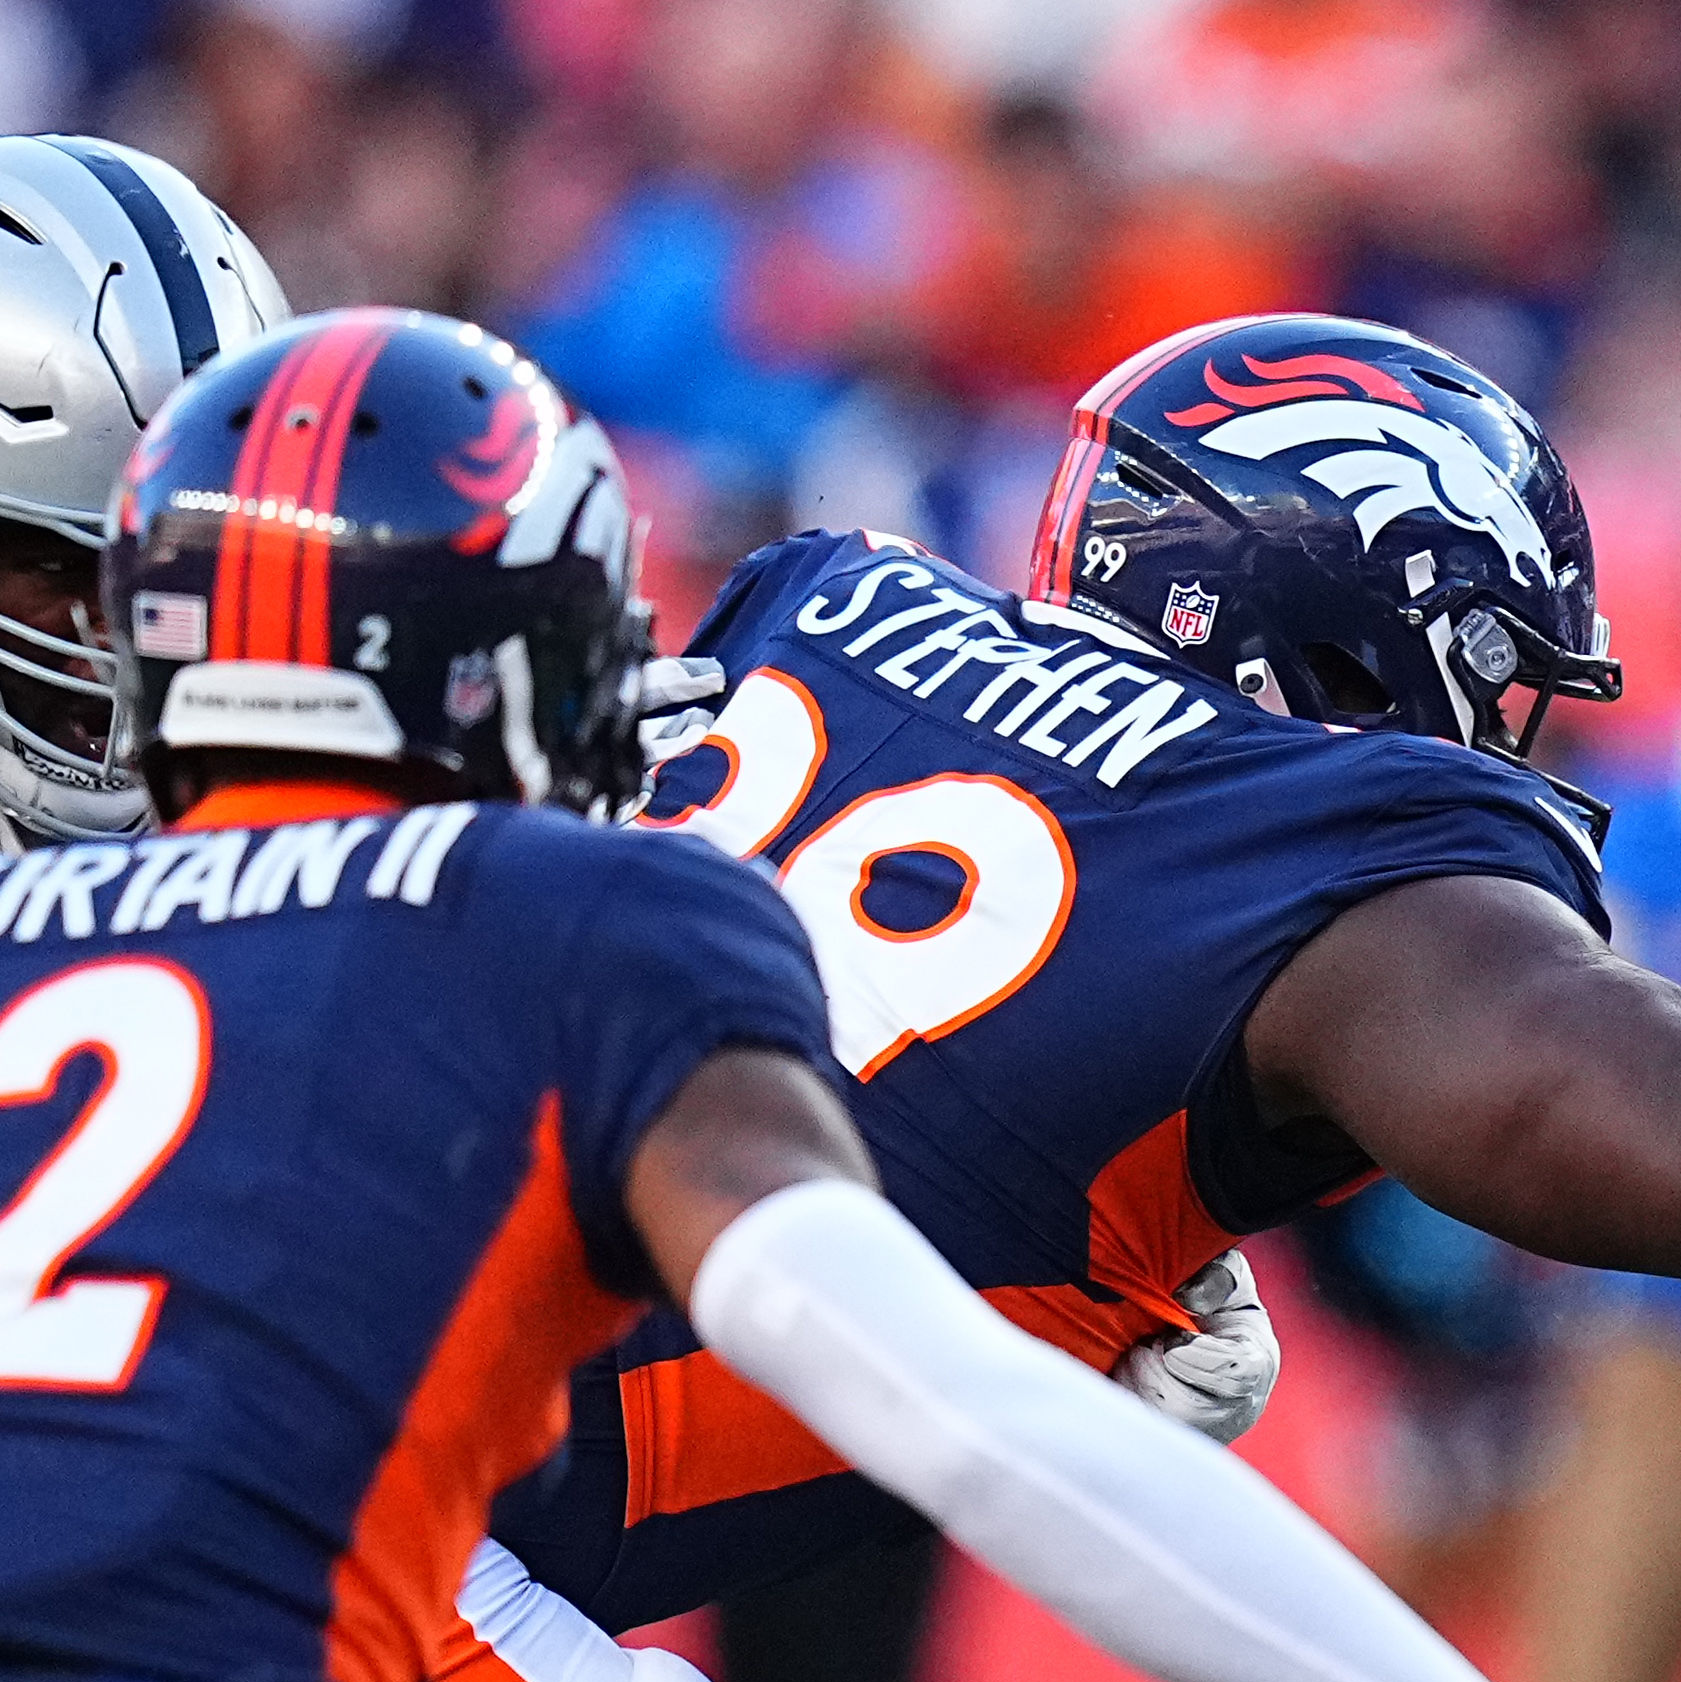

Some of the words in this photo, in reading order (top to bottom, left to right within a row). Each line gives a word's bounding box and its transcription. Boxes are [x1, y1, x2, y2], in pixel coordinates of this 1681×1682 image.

[1081, 536, 1127, 583] 99
[353, 613, 393, 672] 2
[796, 562, 1219, 789] STEPHEN
[366, 801, 478, 908] II
[0, 952, 213, 1393] 2
